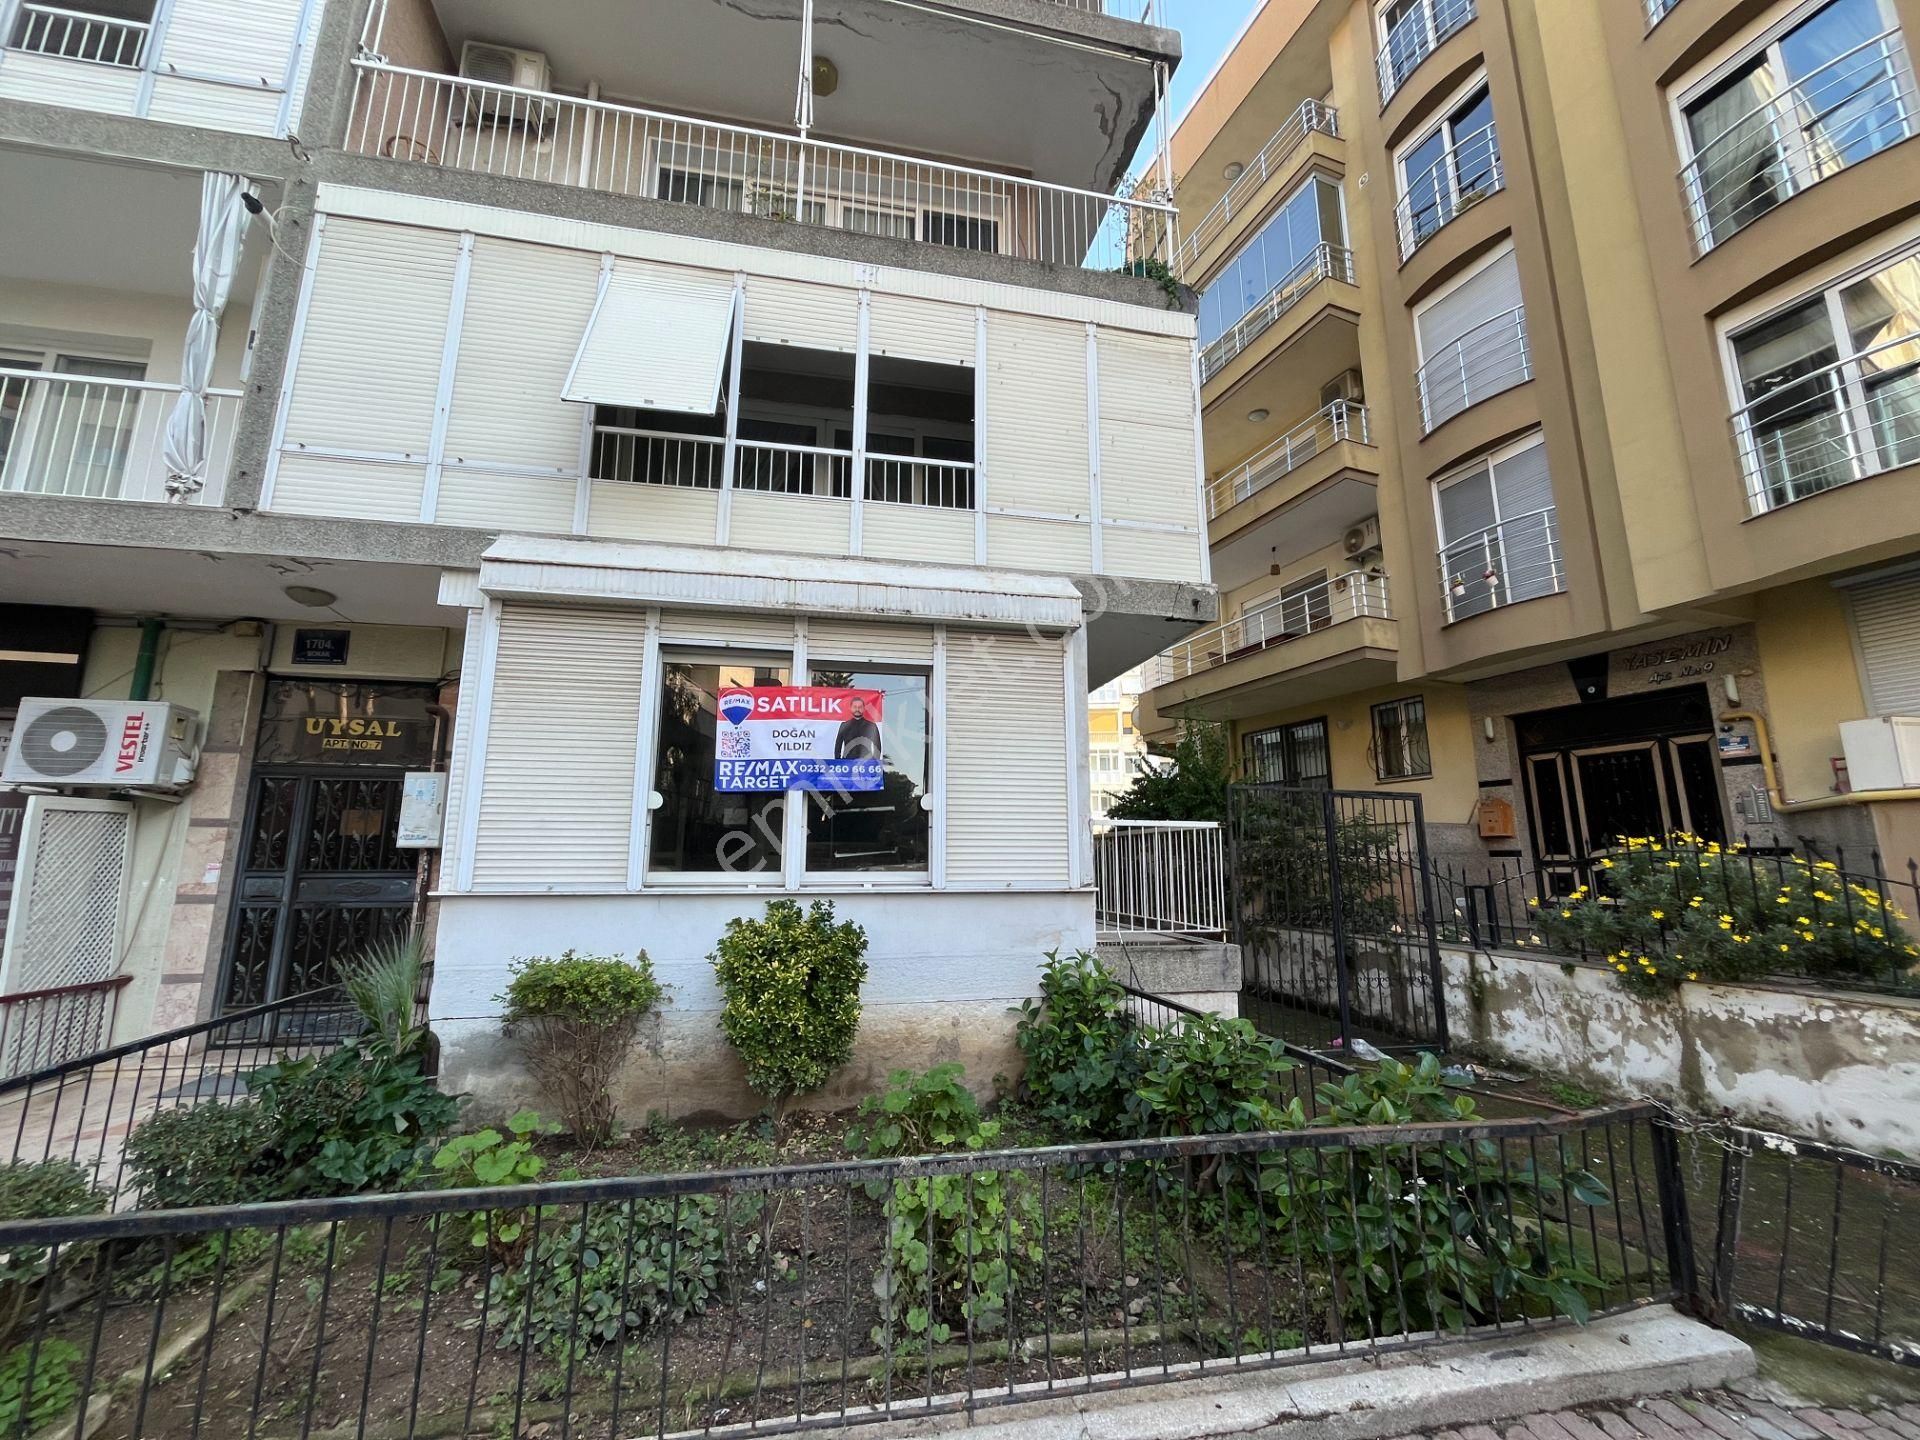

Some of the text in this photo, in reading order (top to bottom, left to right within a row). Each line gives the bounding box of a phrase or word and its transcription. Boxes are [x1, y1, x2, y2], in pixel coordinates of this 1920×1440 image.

[723, 695, 751, 706] RE/MAX
[757, 696, 843, 714] SATILIK
[305, 717, 402, 737] UYSAL
[772, 727, 816, 739] DOĞAN
[115, 711, 145, 773] VESTEL
[775, 742, 812, 751] YILDIZ
[719, 760, 882, 776] RE/MAX 0232 260 66 66
[719, 775, 791, 789] TARGET
